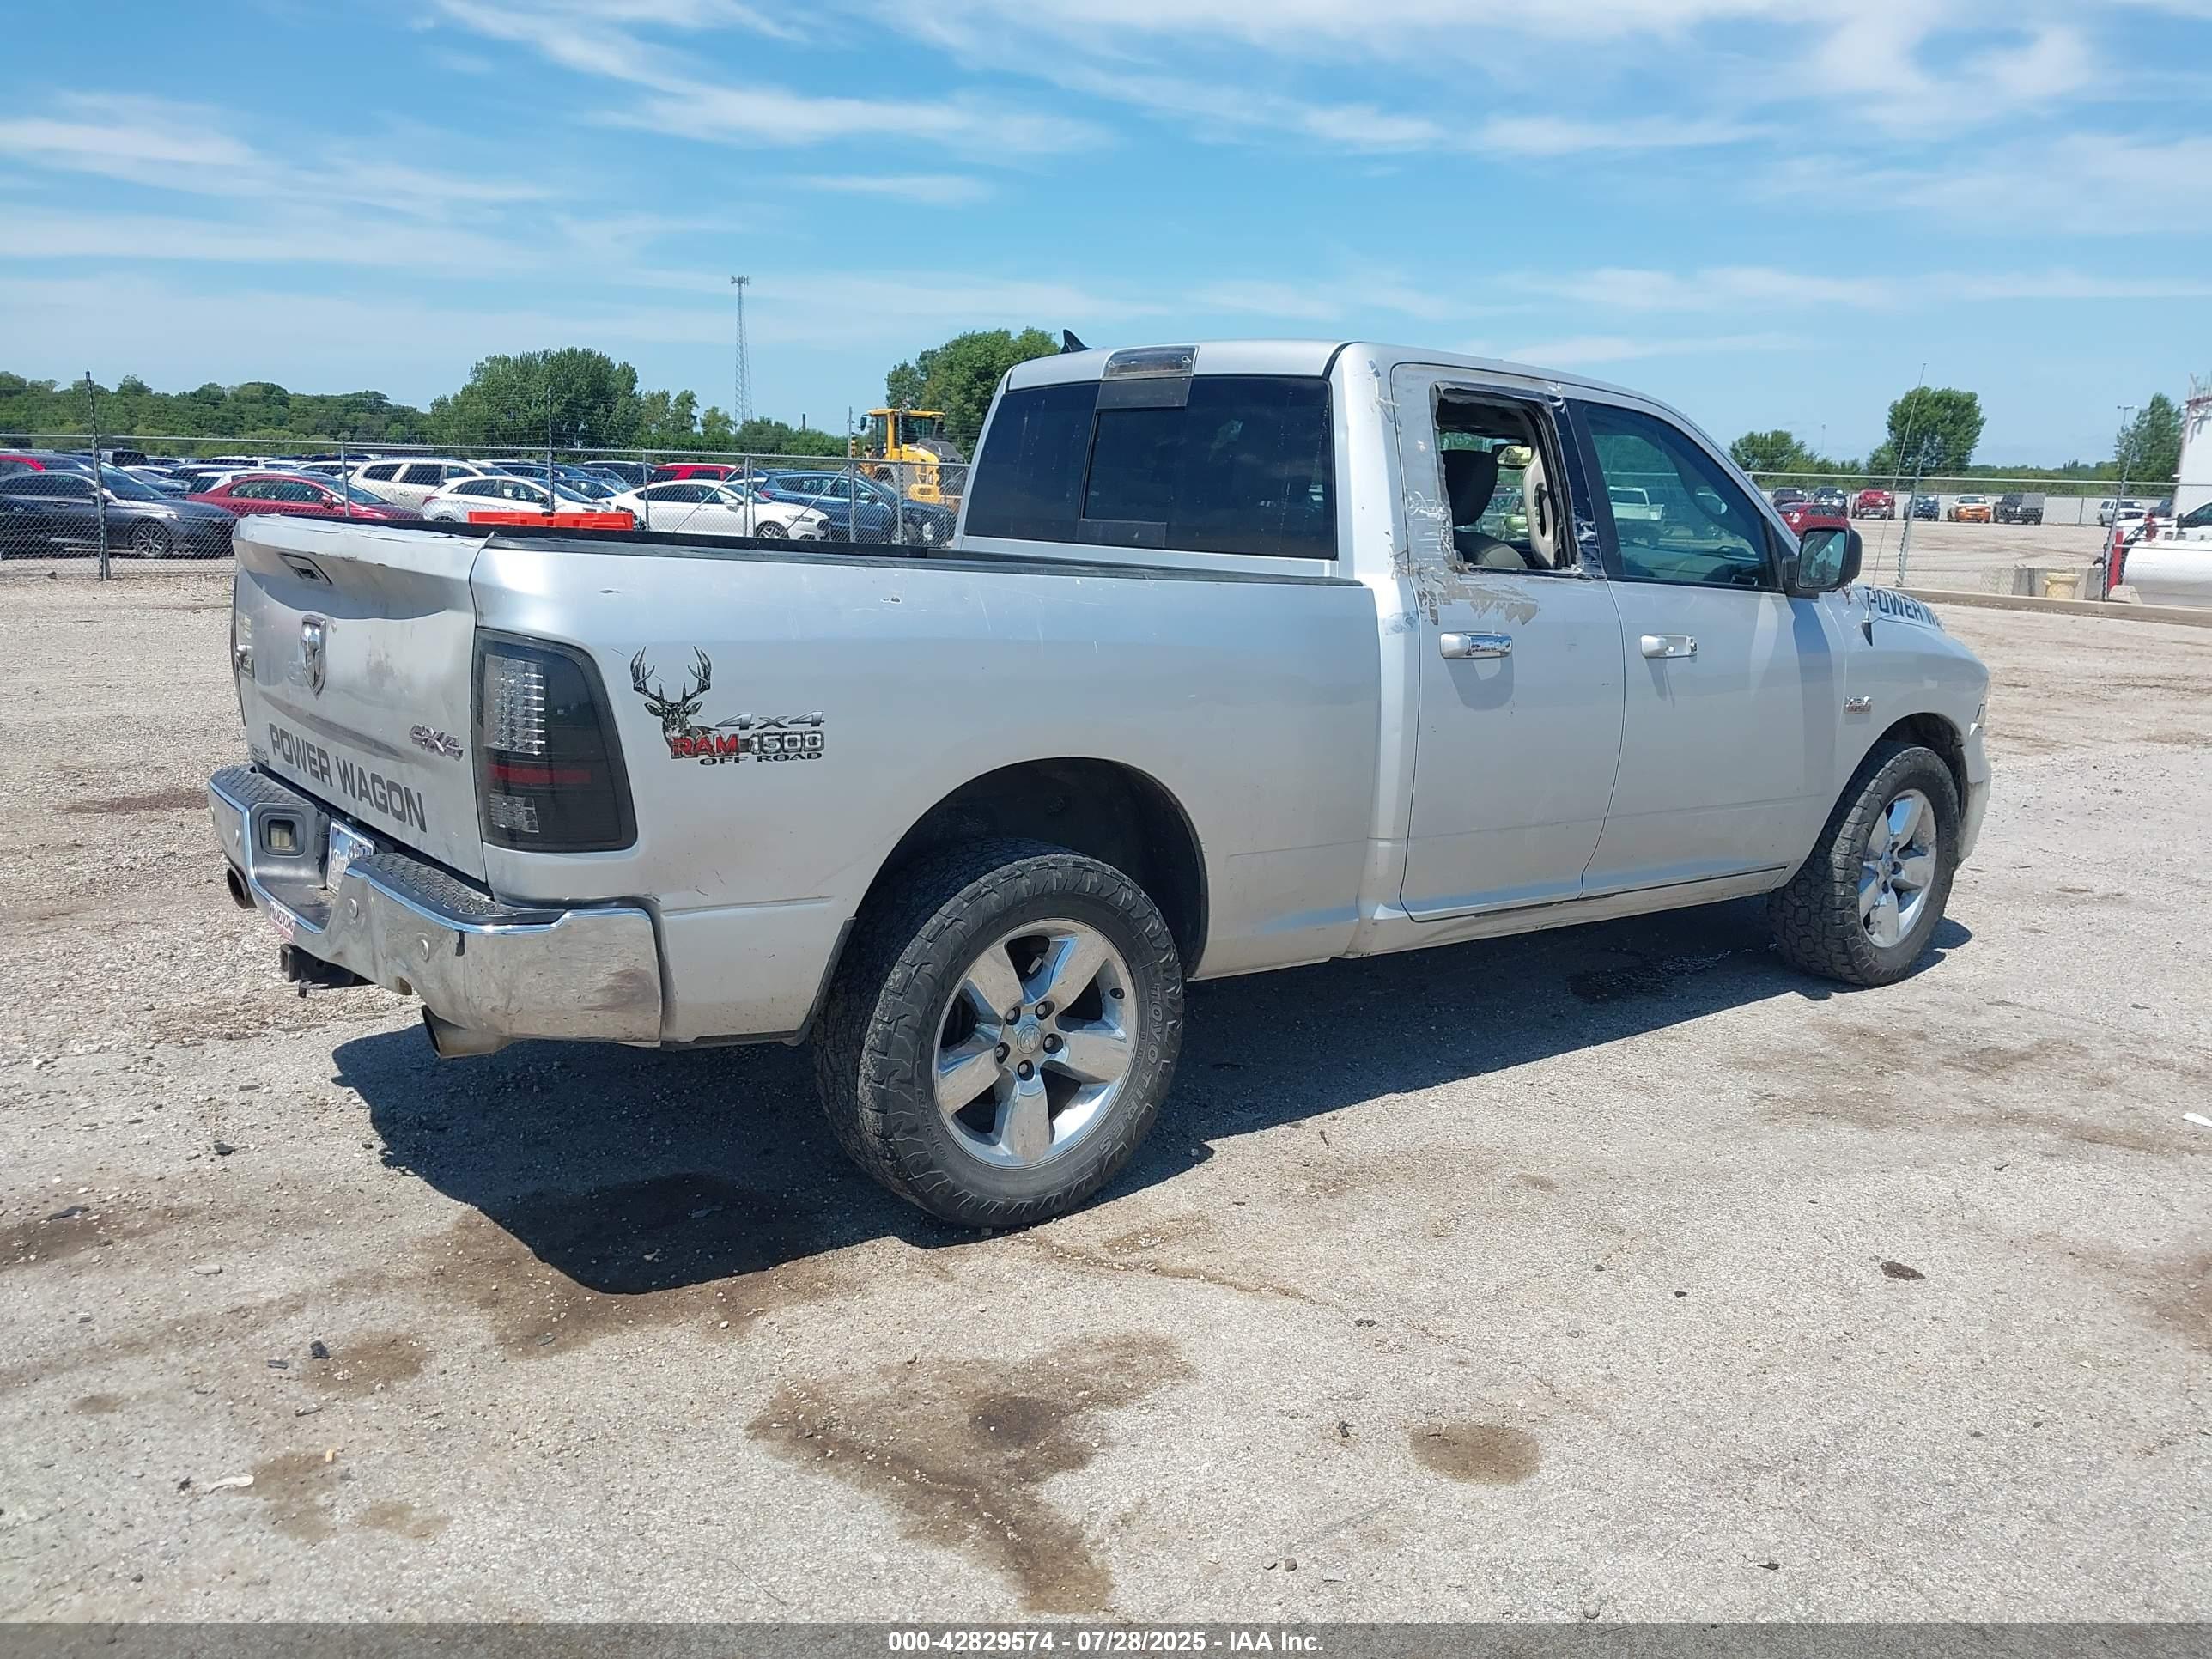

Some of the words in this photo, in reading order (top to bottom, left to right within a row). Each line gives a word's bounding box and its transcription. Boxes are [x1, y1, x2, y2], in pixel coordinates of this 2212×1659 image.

[671, 733, 740, 760] RAM
[746, 731, 824, 755] 1500
[699, 756, 749, 766] OFF
[757, 752, 823, 763] ROAD
[269, 722, 334, 787] POWER
[335, 755, 427, 833] WAGON
[1098, 1071, 1152, 1156] TIRES
